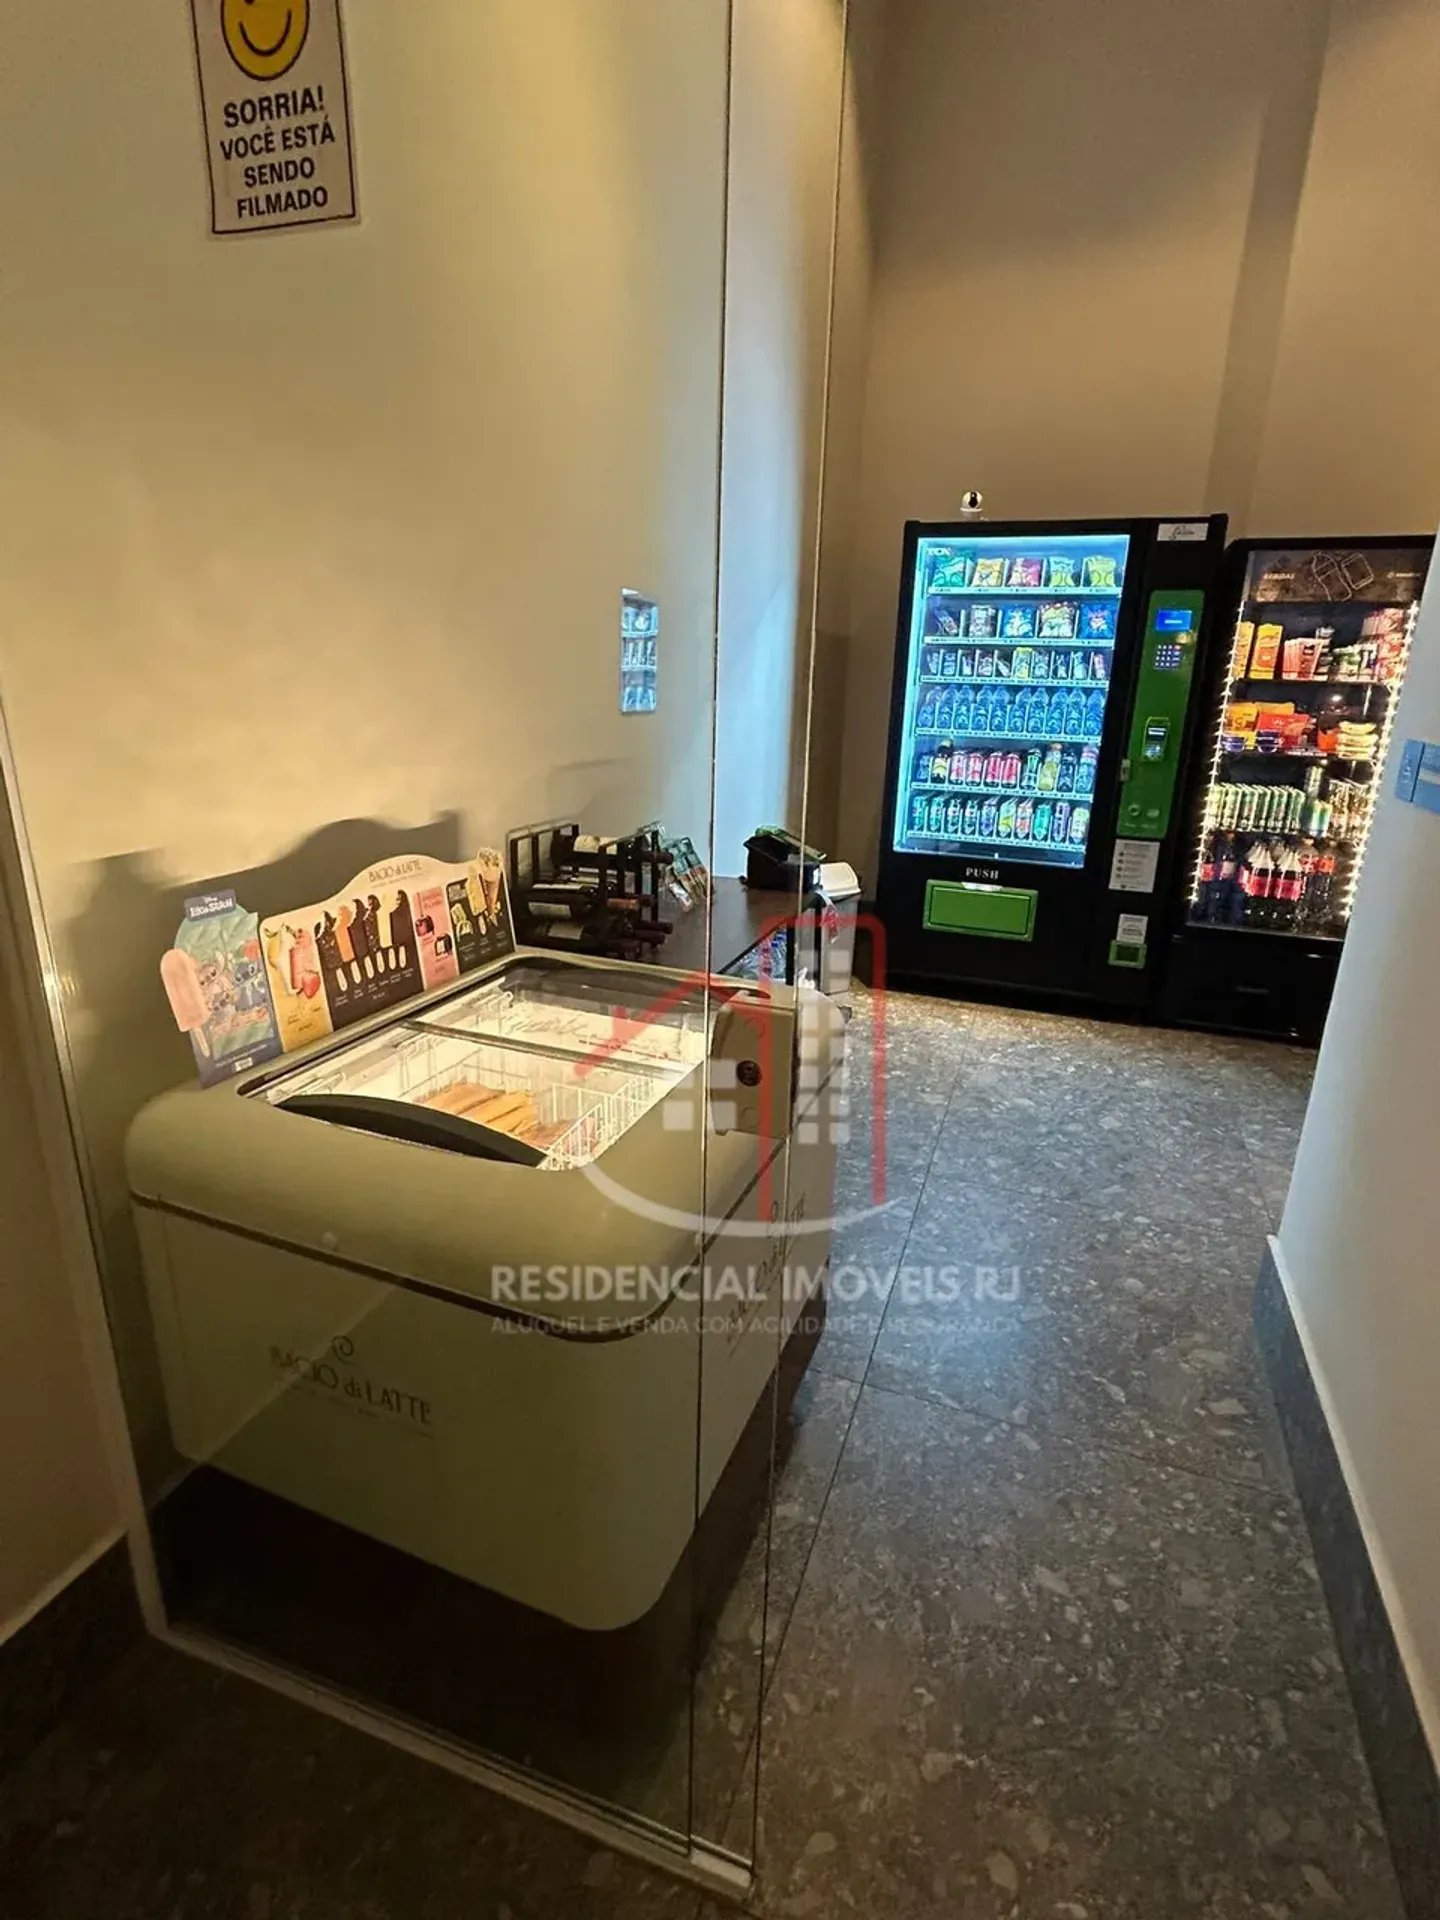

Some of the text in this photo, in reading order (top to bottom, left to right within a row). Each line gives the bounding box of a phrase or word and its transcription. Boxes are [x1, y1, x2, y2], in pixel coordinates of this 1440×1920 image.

[224, 85, 325, 128] SORRIA!
[220, 114, 335, 161] VOCÊ ESTÁ
[244, 157, 316, 188] SENDO
[237, 186, 329, 219] FILMADO
[965, 866, 999, 880] PUSH
